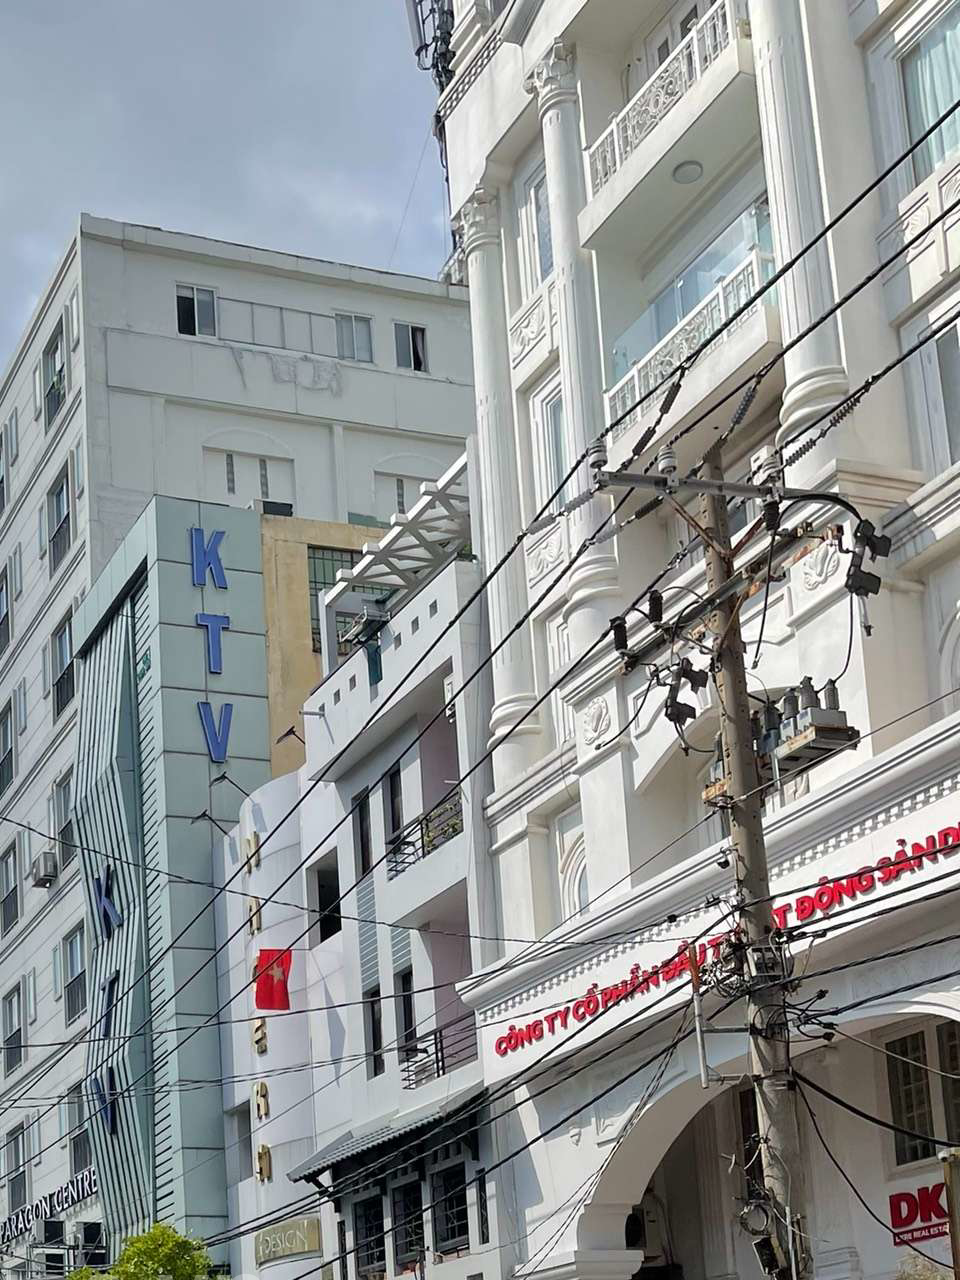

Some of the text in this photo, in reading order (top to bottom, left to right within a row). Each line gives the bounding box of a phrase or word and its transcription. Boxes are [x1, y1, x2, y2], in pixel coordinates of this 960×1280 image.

[190, 527, 233, 764] KTV
[795, 866, 876, 921] ĐỘNG
[877, 835, 938, 884] SẢN
[495, 1019, 543, 1057] CÔNG
[543, 1006, 570, 1036] TY
[0, 1167, 98, 1243] PARAGON CENTRE
